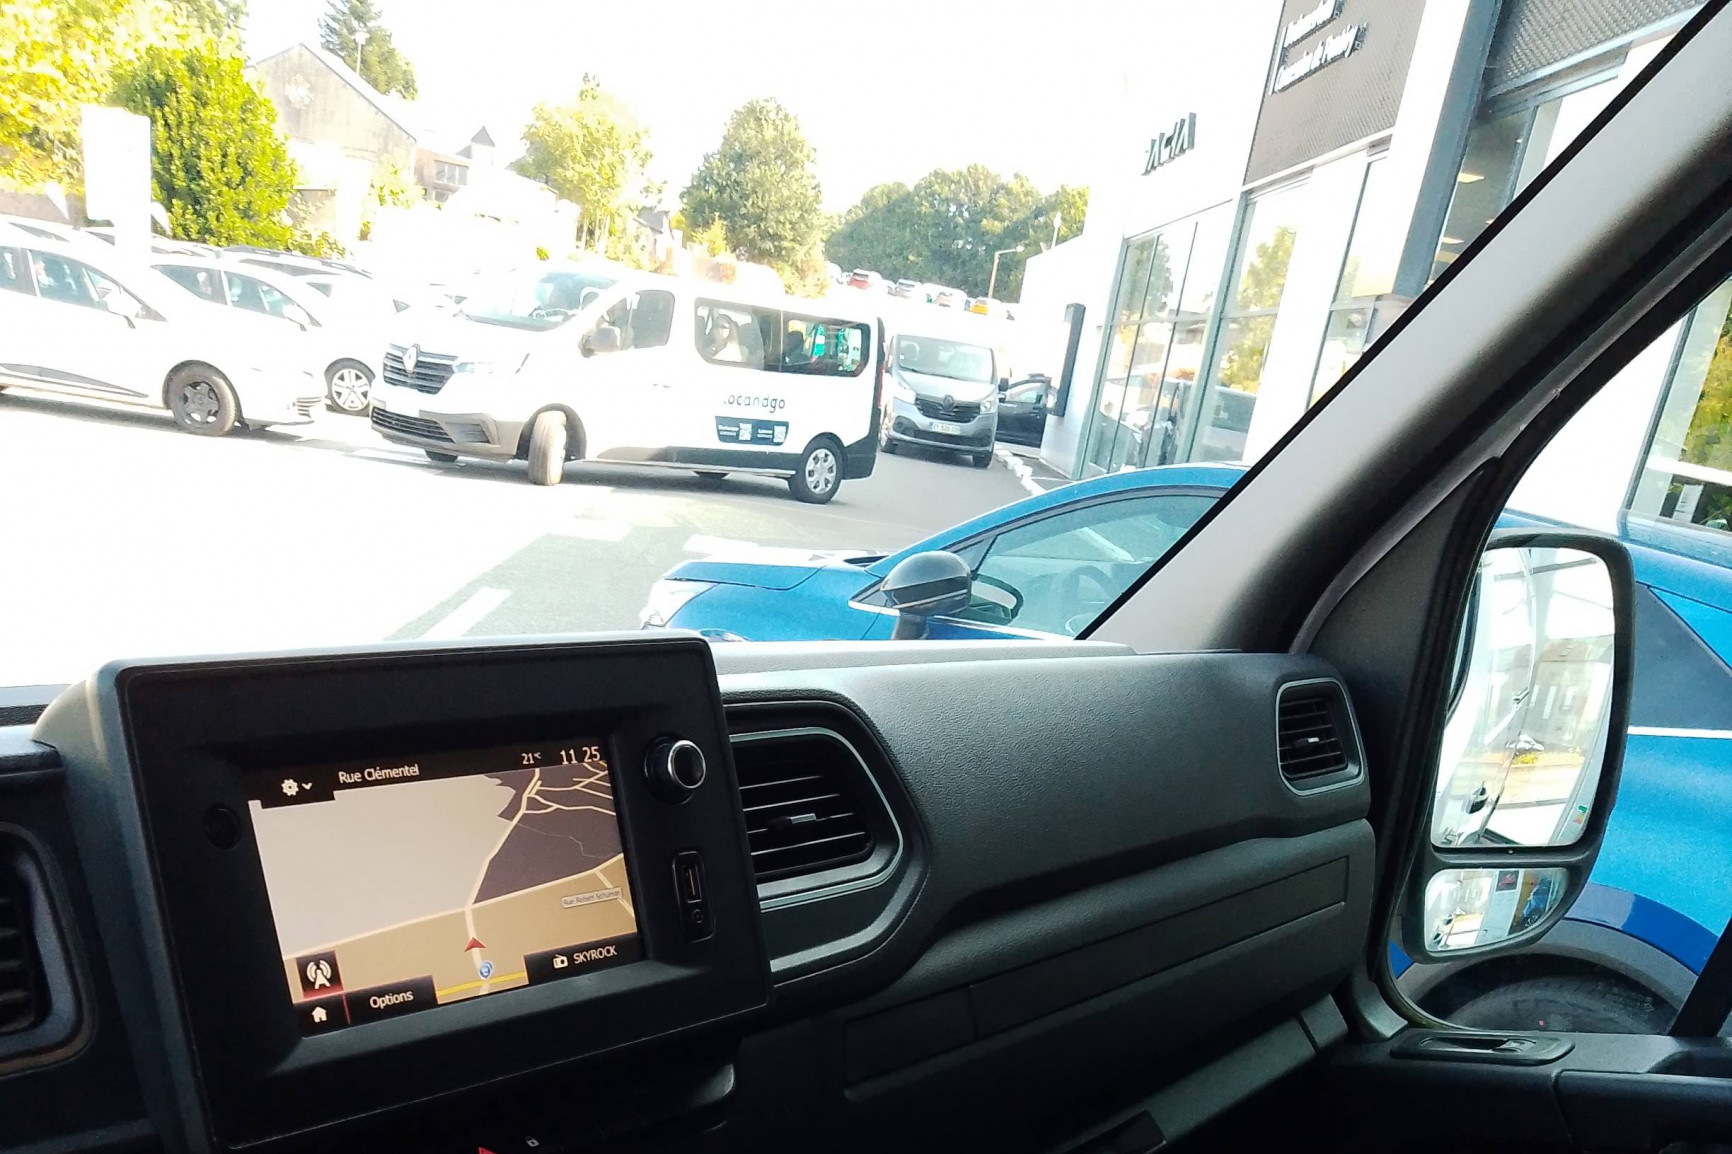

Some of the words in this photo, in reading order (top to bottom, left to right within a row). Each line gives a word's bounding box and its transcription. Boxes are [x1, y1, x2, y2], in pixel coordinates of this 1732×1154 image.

[723, 394, 786, 414] ocandgo
[338, 771, 362, 784] Rue
[364, 763, 420, 781] Clémentel
[573, 945, 618, 964] SKYROCK
[369, 990, 414, 1009] Options
